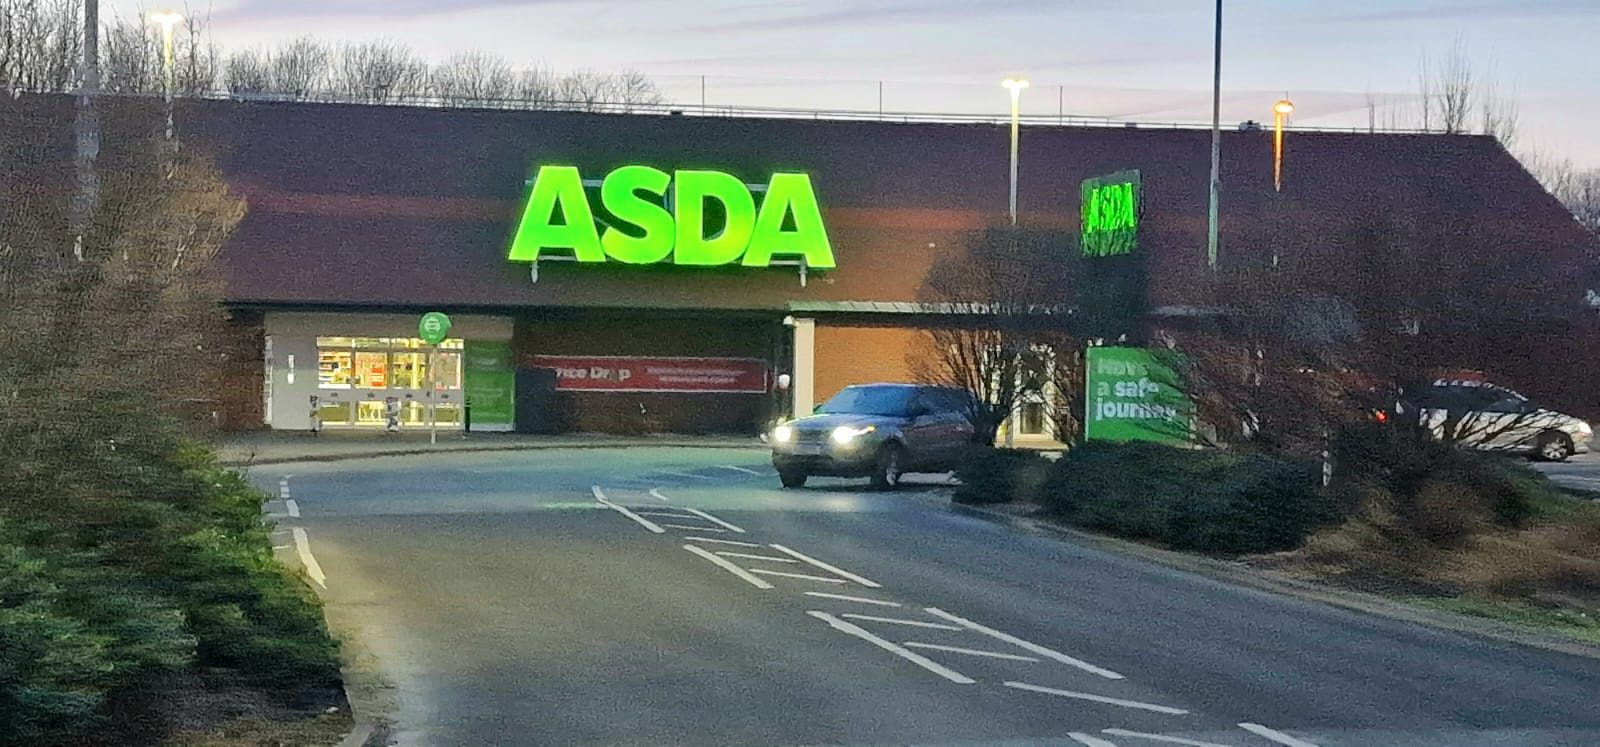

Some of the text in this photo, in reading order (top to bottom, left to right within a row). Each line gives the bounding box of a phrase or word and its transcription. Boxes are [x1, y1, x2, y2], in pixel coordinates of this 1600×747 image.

[508, 166, 836, 267] ASDA
[1088, 183, 1134, 232] ASDA
[556, 368, 588, 379] rice
[1097, 382, 1110, 396] a
